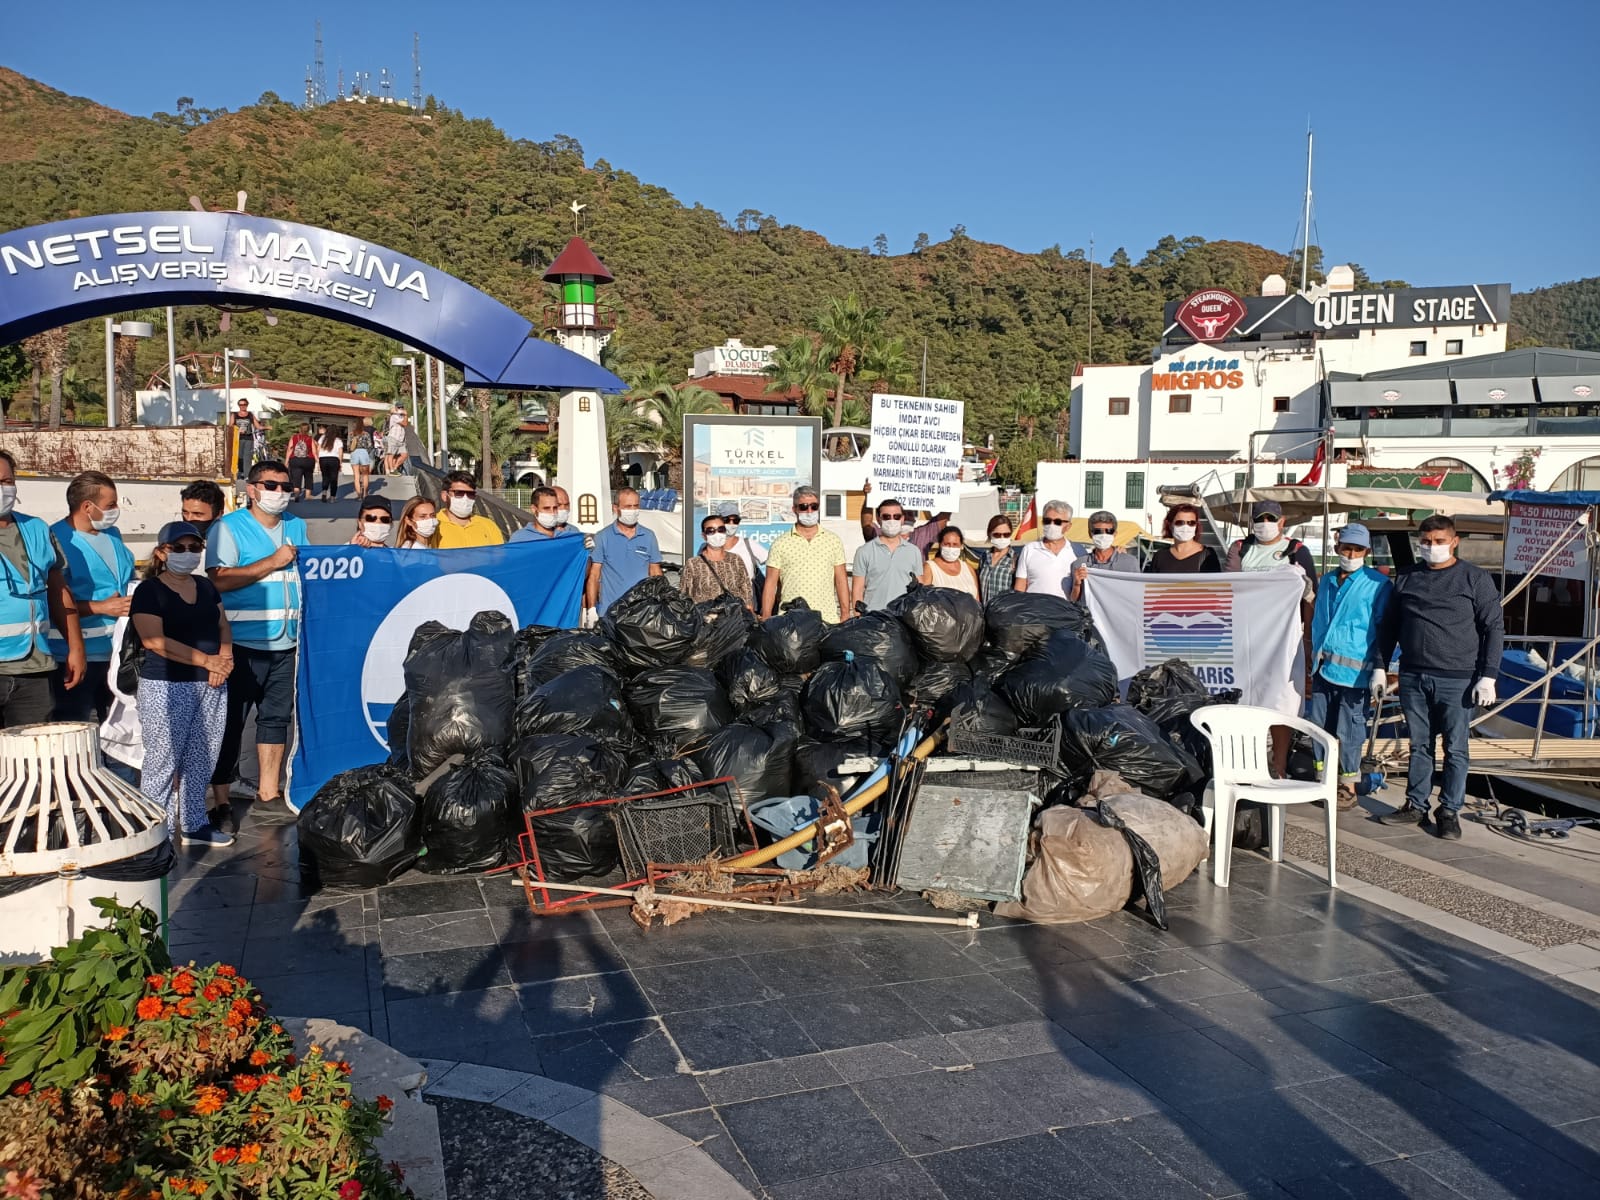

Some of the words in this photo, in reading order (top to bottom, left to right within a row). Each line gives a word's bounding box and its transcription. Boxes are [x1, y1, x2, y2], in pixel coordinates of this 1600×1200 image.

[0, 225, 214, 275] NETSEL
[73, 256, 229, 291] ALIŞVERİŞ
[1190, 293, 1232, 307] STEAKHOUSE
[1201, 304, 1222, 313] QUEEN
[1314, 293, 1395, 330] QUEEN
[1413, 297, 1476, 322] STAGE
[719, 348, 769, 361] VOGUE
[725, 360, 763, 369] DIAMOND
[1168, 356, 1239, 372] marina
[881, 398, 891, 408] BU
[924, 415, 940, 426] AVCI
[921, 429, 960, 441] BEKLEMEDEN
[724, 448, 784, 459] TÜRKEL
[921, 443, 946, 453] OLARAK
[1520, 505, 1539, 518] %50
[1512, 527, 1532, 535] TURA
[305, 556, 364, 580] 2020
